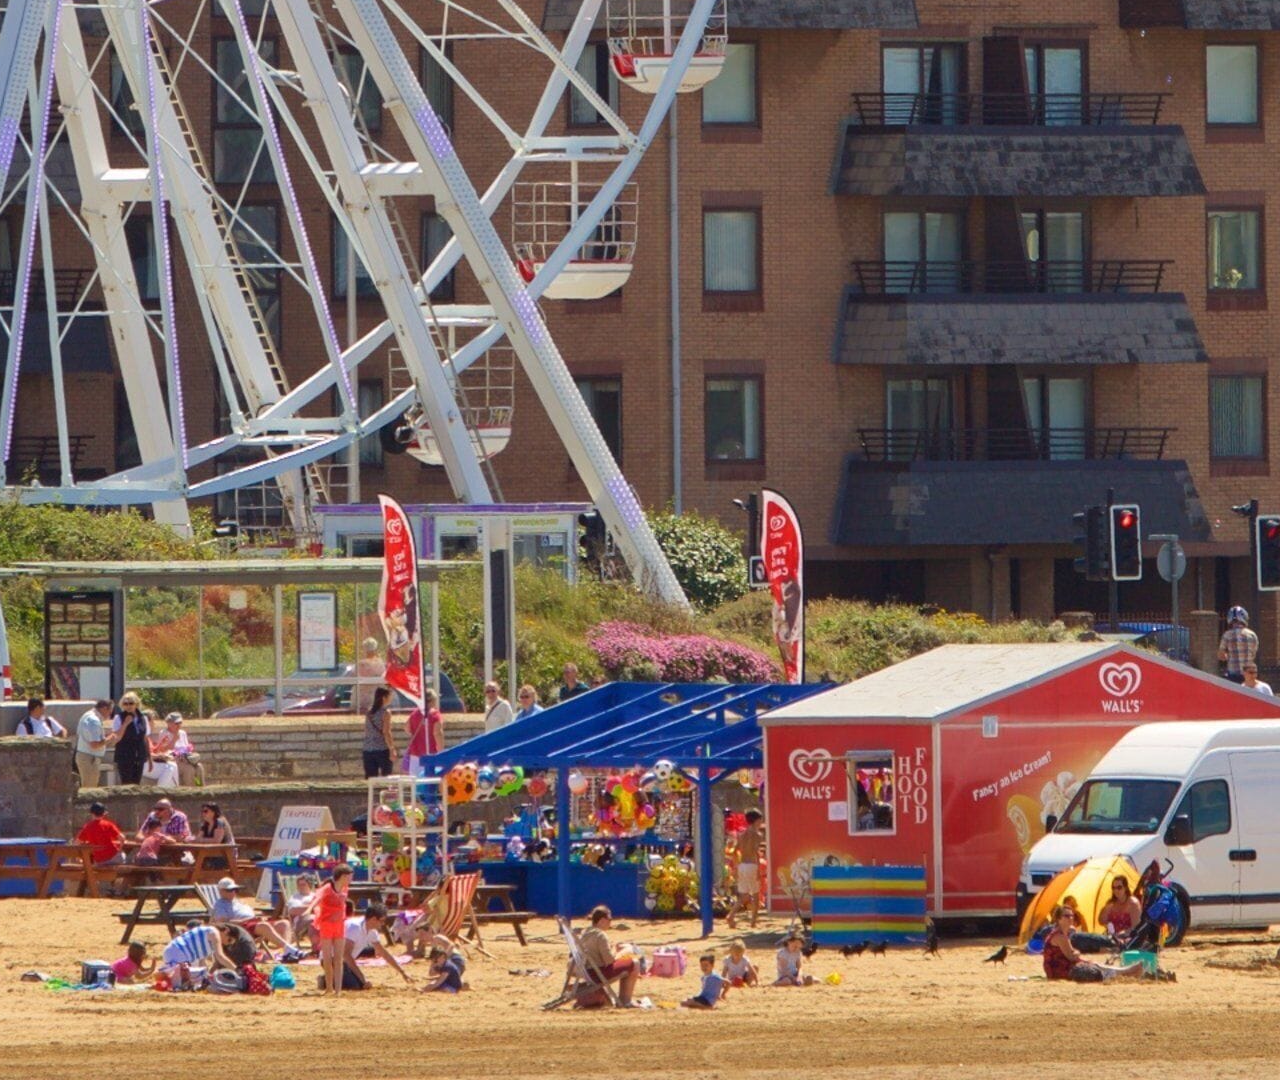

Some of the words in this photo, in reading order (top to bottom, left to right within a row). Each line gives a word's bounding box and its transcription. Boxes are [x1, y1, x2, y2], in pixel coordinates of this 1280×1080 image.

[898, 756, 912, 813] HOT
[913, 747, 928, 824] FOOD
[972, 781, 999, 801] Fancy
[999, 775, 1011, 788] an
[1009, 768, 1024, 784] Ice
